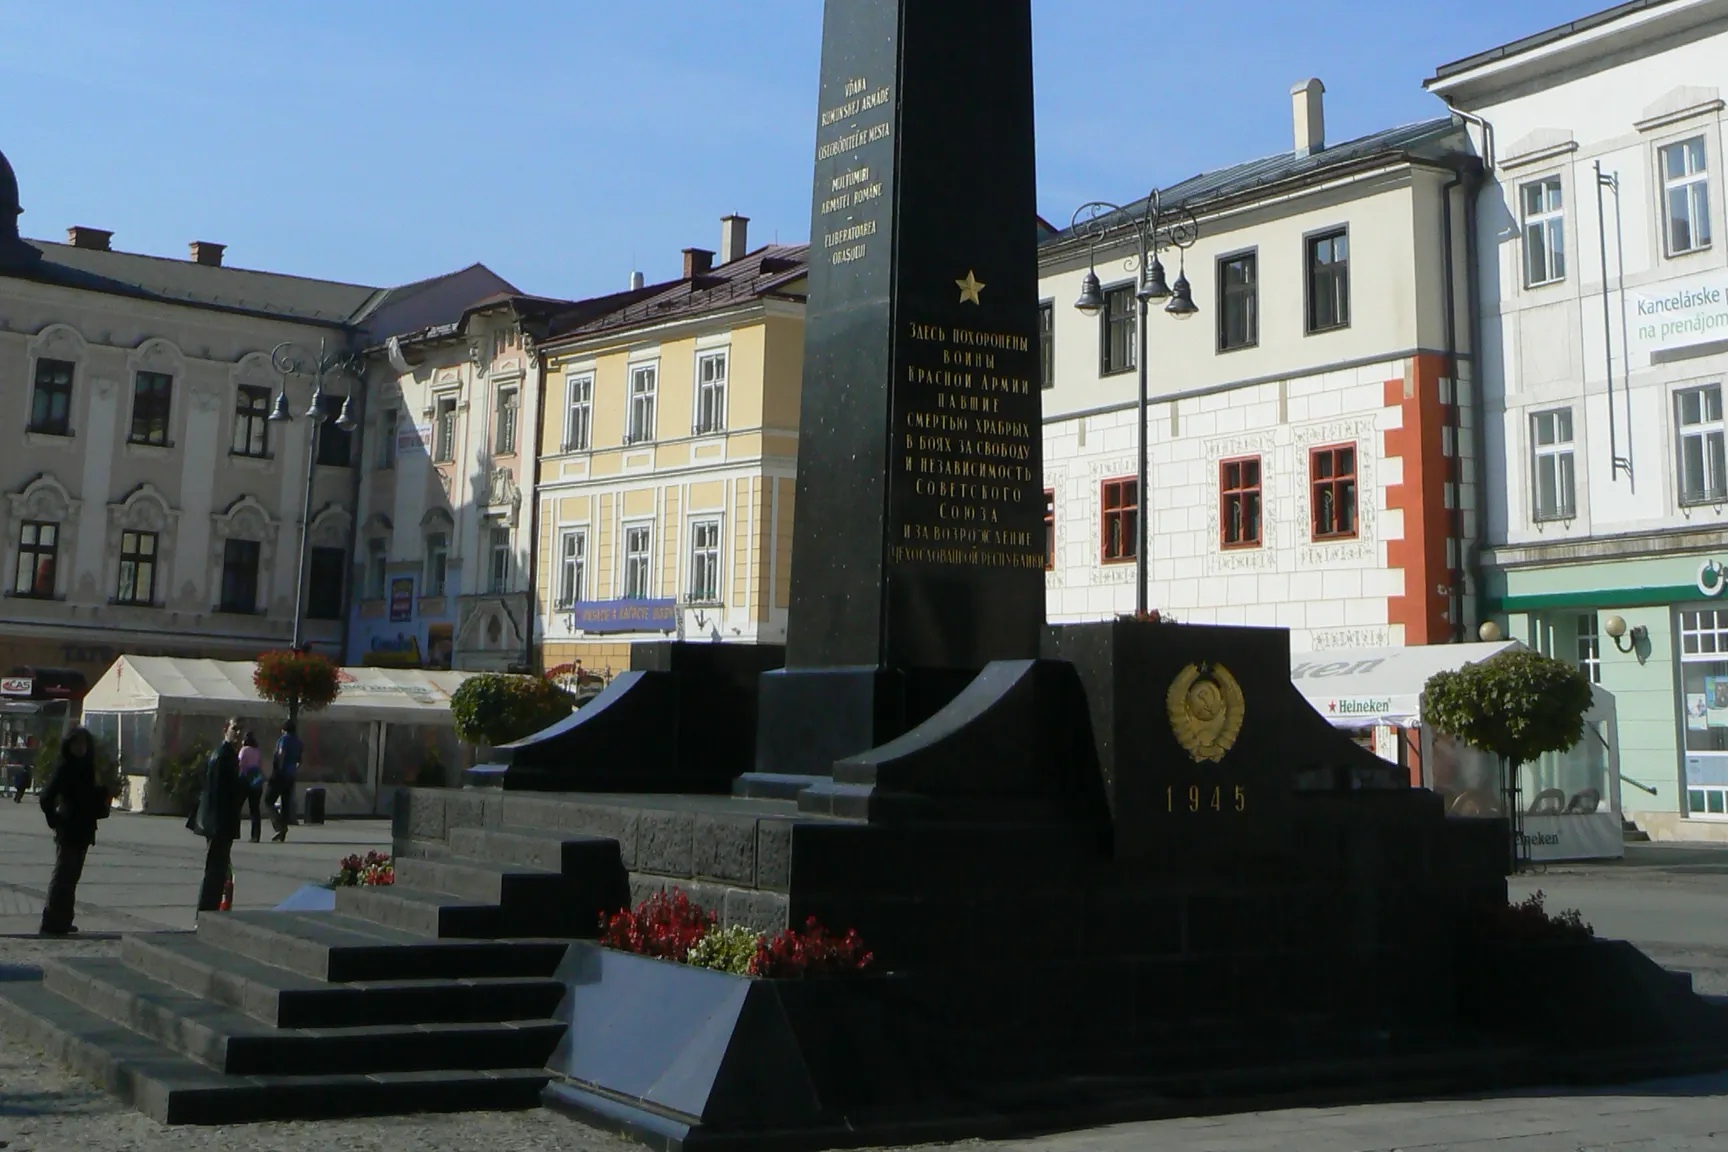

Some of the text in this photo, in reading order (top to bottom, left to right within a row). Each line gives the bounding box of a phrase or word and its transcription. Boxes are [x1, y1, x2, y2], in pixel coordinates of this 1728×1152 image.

[868, 122, 890, 143] MESTA
[821, 193, 850, 215] ARMATEI
[1637, 286, 1720, 316] Kancelárske
[909, 322, 1028, 352] ЗДЕСЬ ПОХОРОНЕНЫ
[1638, 312, 1728, 342] na prenájom
[943, 349, 995, 369] ВОИНЫ
[981, 374, 1029, 395] АРМИИ
[938, 393, 1000, 413] ПАВШИЕ
[907, 412, 1029, 438] СМЕРТЬЮ ХРАБРЫХ
[906, 434, 1031, 460] В БОЯХ ЗА СВОБОДУ
[905, 456, 1032, 481] И НЕЗАВИСИМОСТЬ
[916, 478, 1022, 503] СОВЕТСКОГО
[939, 501, 998, 523] СОЮЗА
[903, 524, 1032, 546] И ЗА ВОЗРОЖДЕНИЕ
[1338, 699, 1390, 713] Heineken
[1166, 784, 1245, 813] 1945
